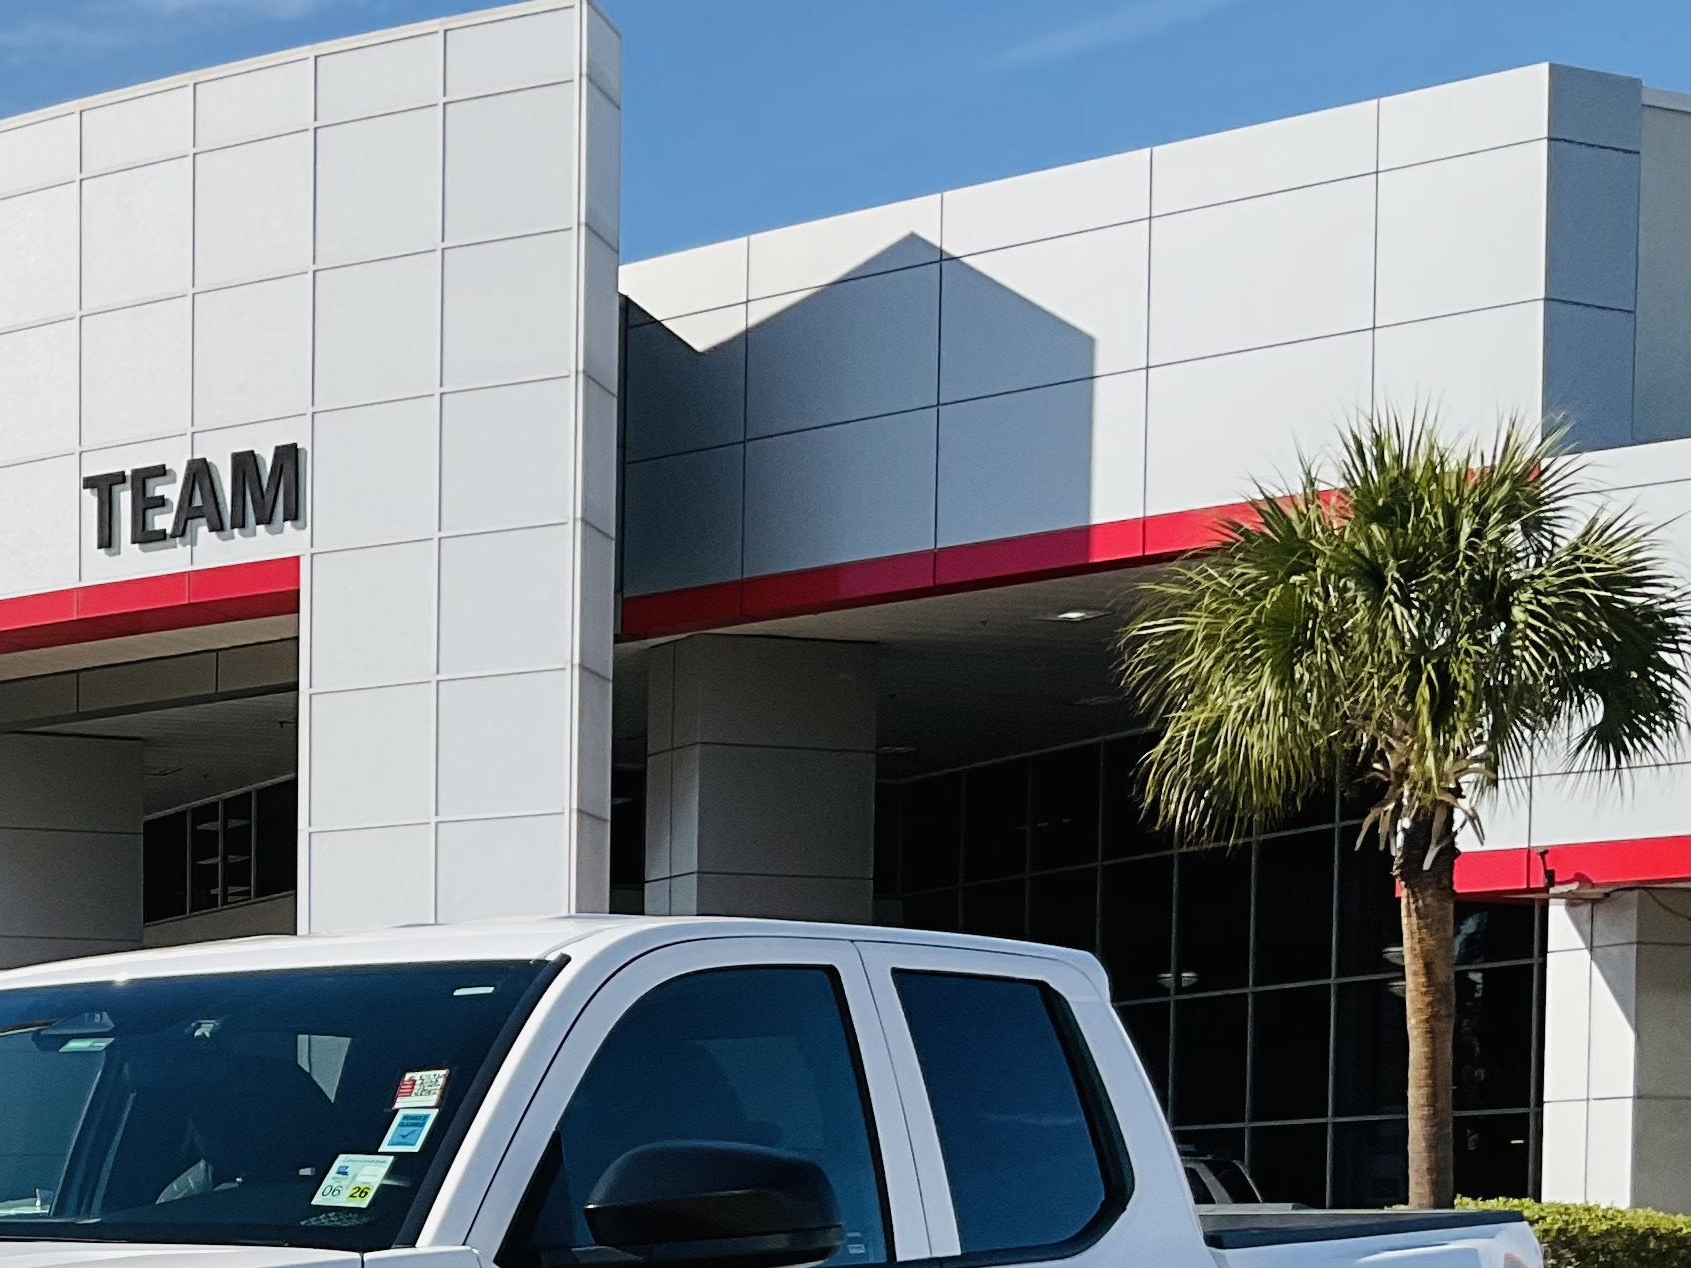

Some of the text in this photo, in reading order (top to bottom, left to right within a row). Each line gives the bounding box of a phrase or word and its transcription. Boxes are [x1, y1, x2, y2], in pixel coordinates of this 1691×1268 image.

[82, 442, 298, 549] TEAM
[322, 1184, 371, 1199] 06 26
